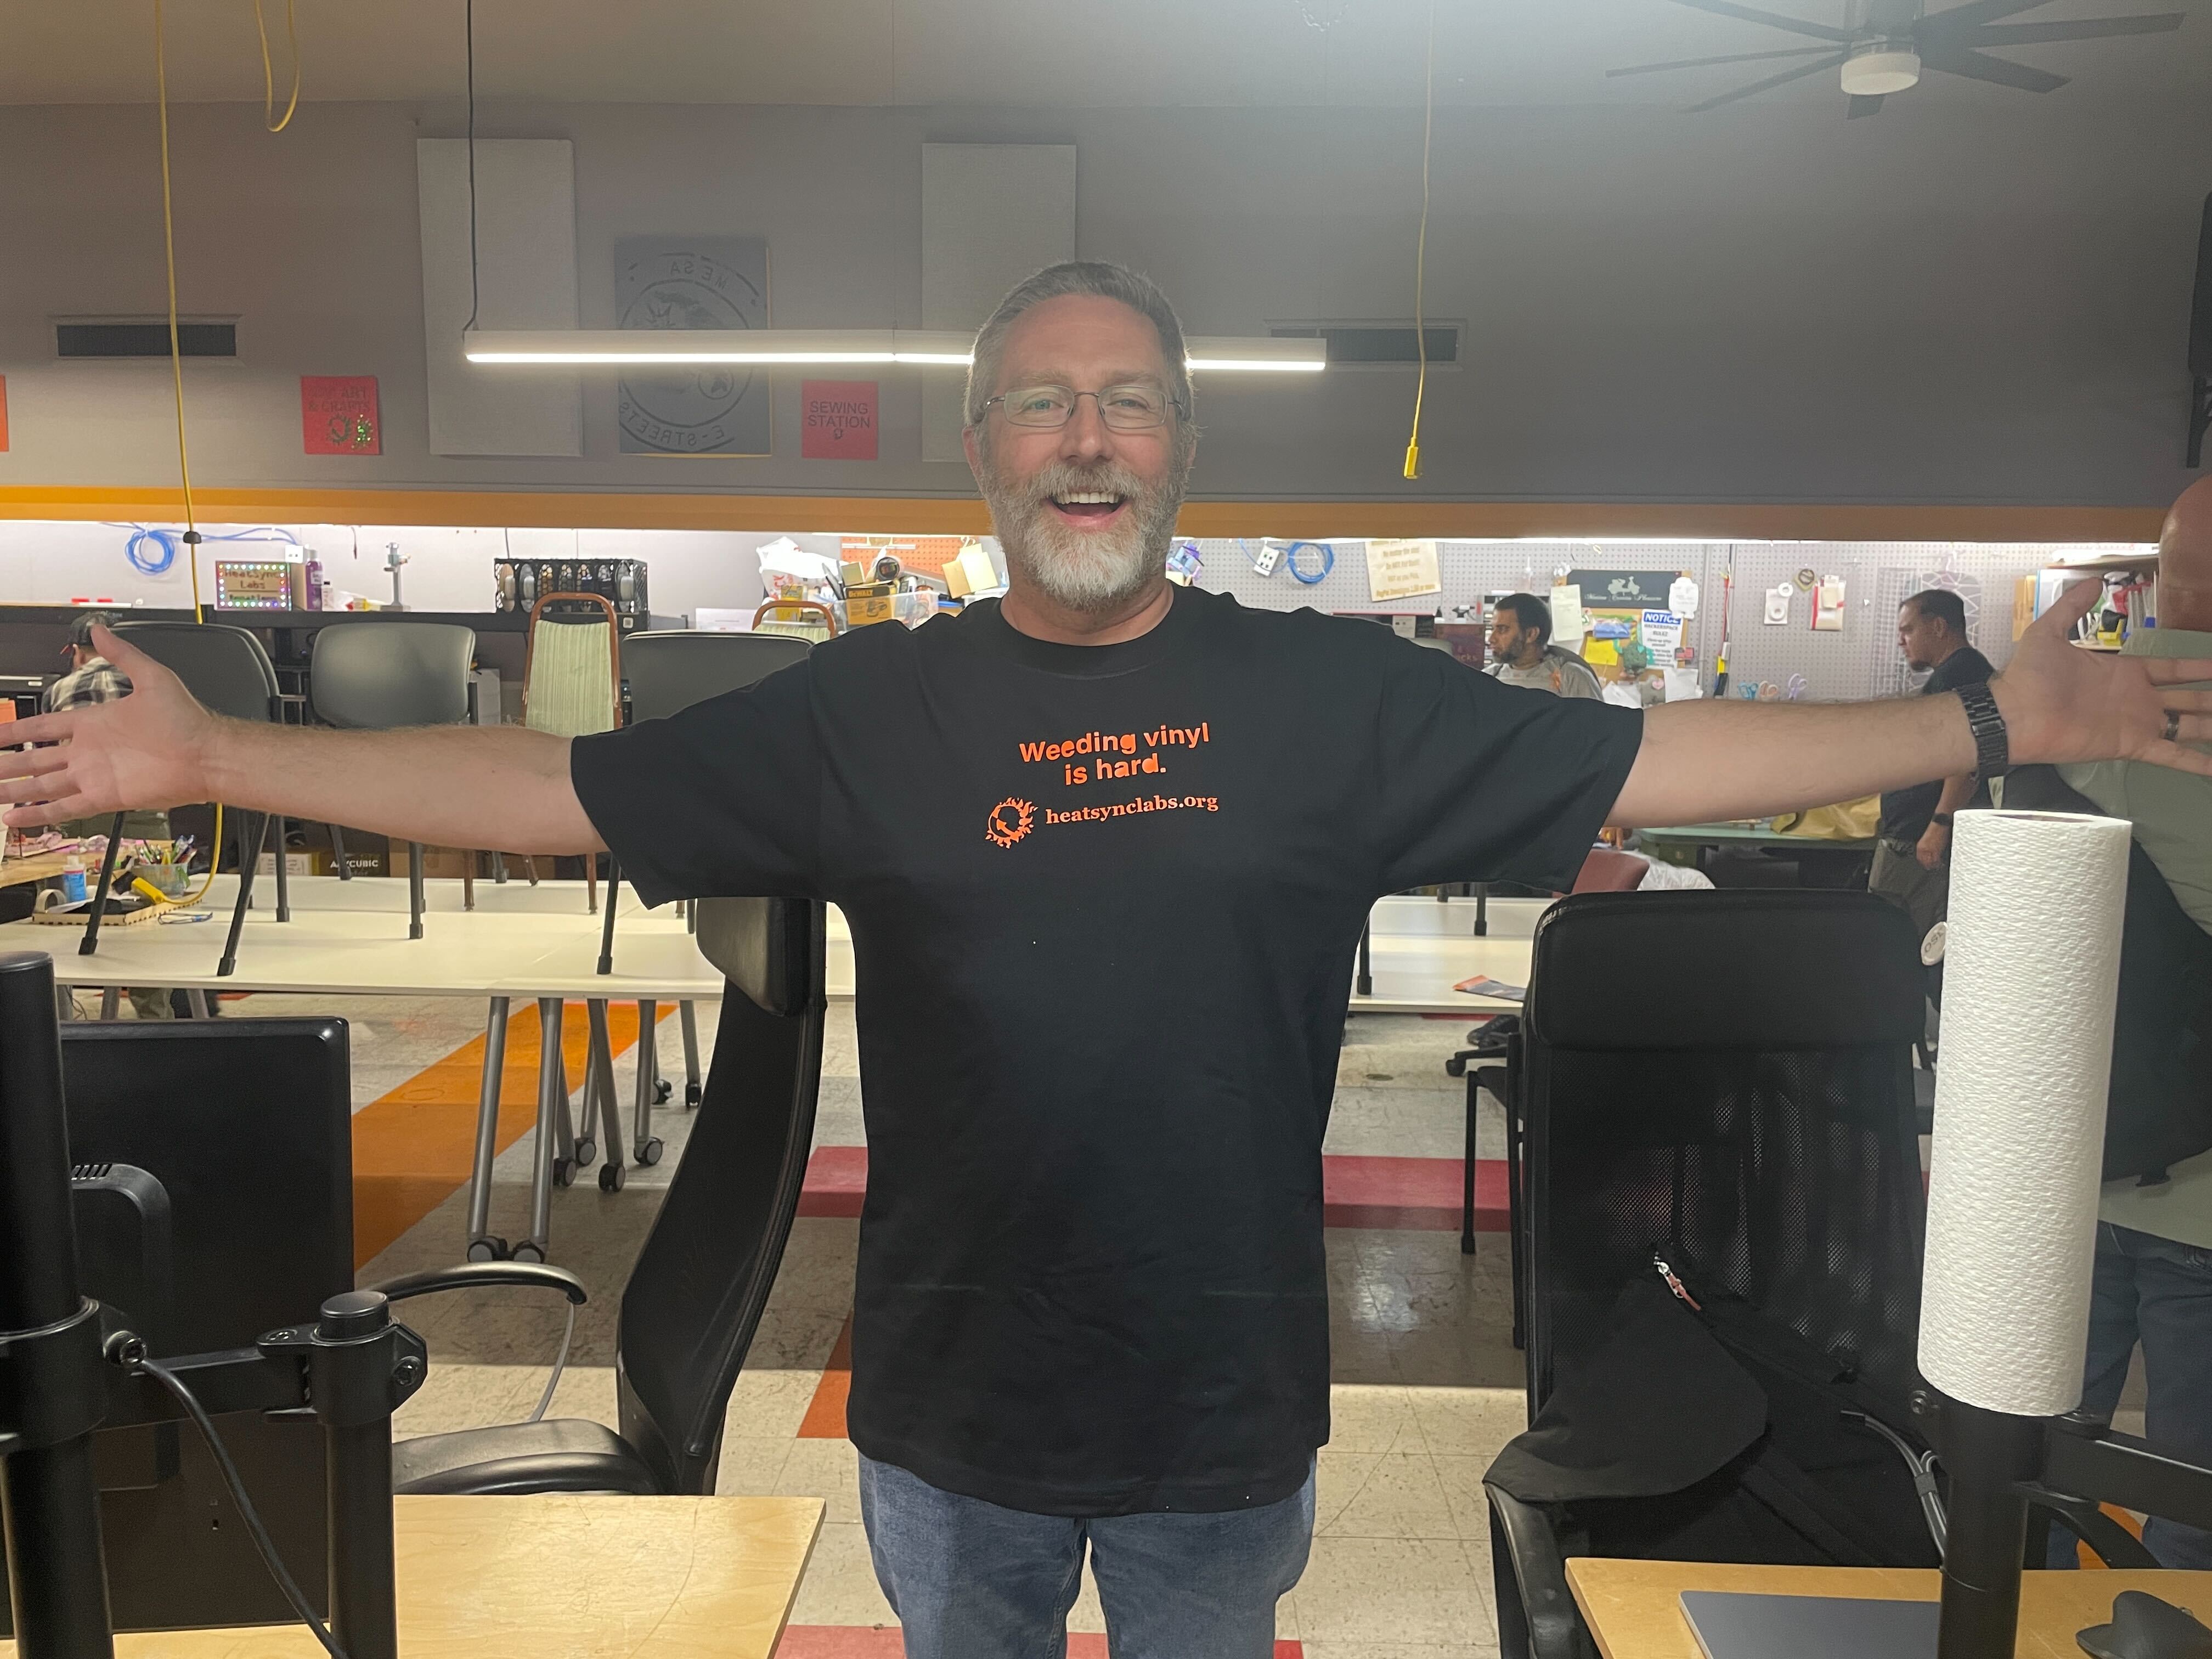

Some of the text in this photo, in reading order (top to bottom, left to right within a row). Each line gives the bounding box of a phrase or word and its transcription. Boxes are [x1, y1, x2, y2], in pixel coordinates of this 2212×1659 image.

[810, 400, 868, 415] SEWING
[808, 414, 870, 428] STATION
[1019, 722, 1209, 763] Weeding vinyl
[1065, 753, 1166, 786] is hard.
[1045, 795, 1219, 825] heatsynclabs.org
[330, 859, 379, 869] ACUBIC
